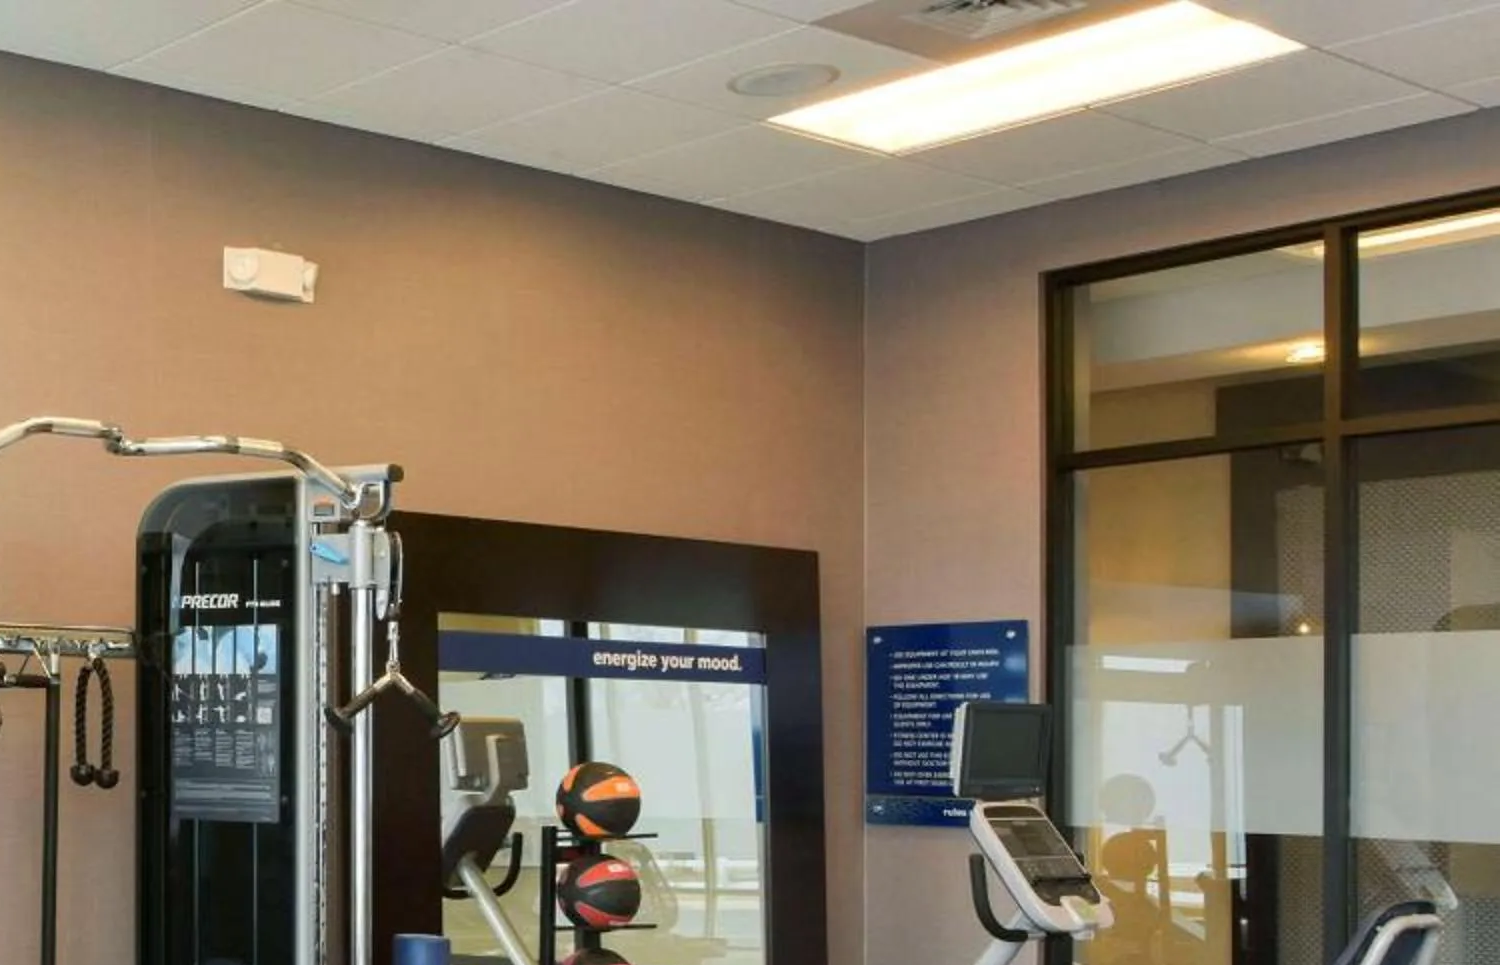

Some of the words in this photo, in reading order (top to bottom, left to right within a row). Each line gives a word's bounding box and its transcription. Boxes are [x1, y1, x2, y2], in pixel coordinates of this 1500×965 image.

[181, 593, 239, 609] PRECOR
[592, 650, 658, 672] energize
[660, 654, 695, 673] your
[697, 653, 743, 673] mood.
